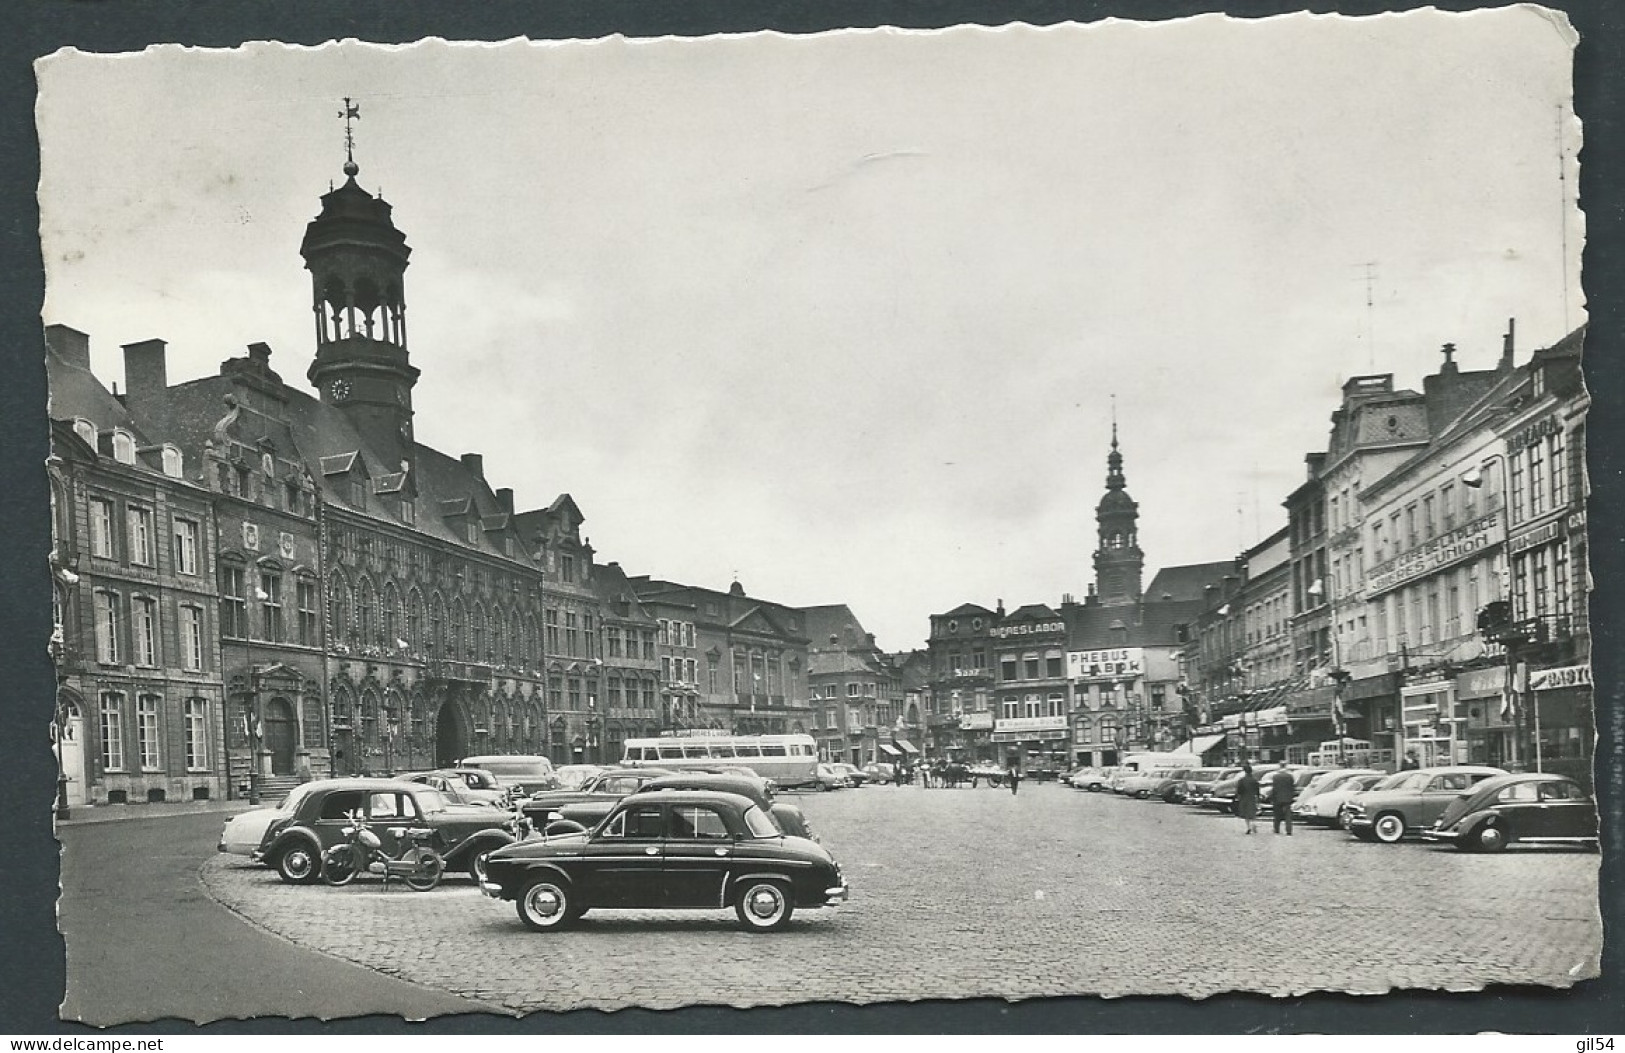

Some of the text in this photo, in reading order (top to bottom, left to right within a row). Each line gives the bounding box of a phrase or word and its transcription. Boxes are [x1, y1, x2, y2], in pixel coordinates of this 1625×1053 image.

[1456, 518, 1497, 541] PLACE
[1435, 533, 1488, 563] UNION
[1029, 621, 1065, 634] LABOR
[1070, 649, 1129, 664] PHEBUS
